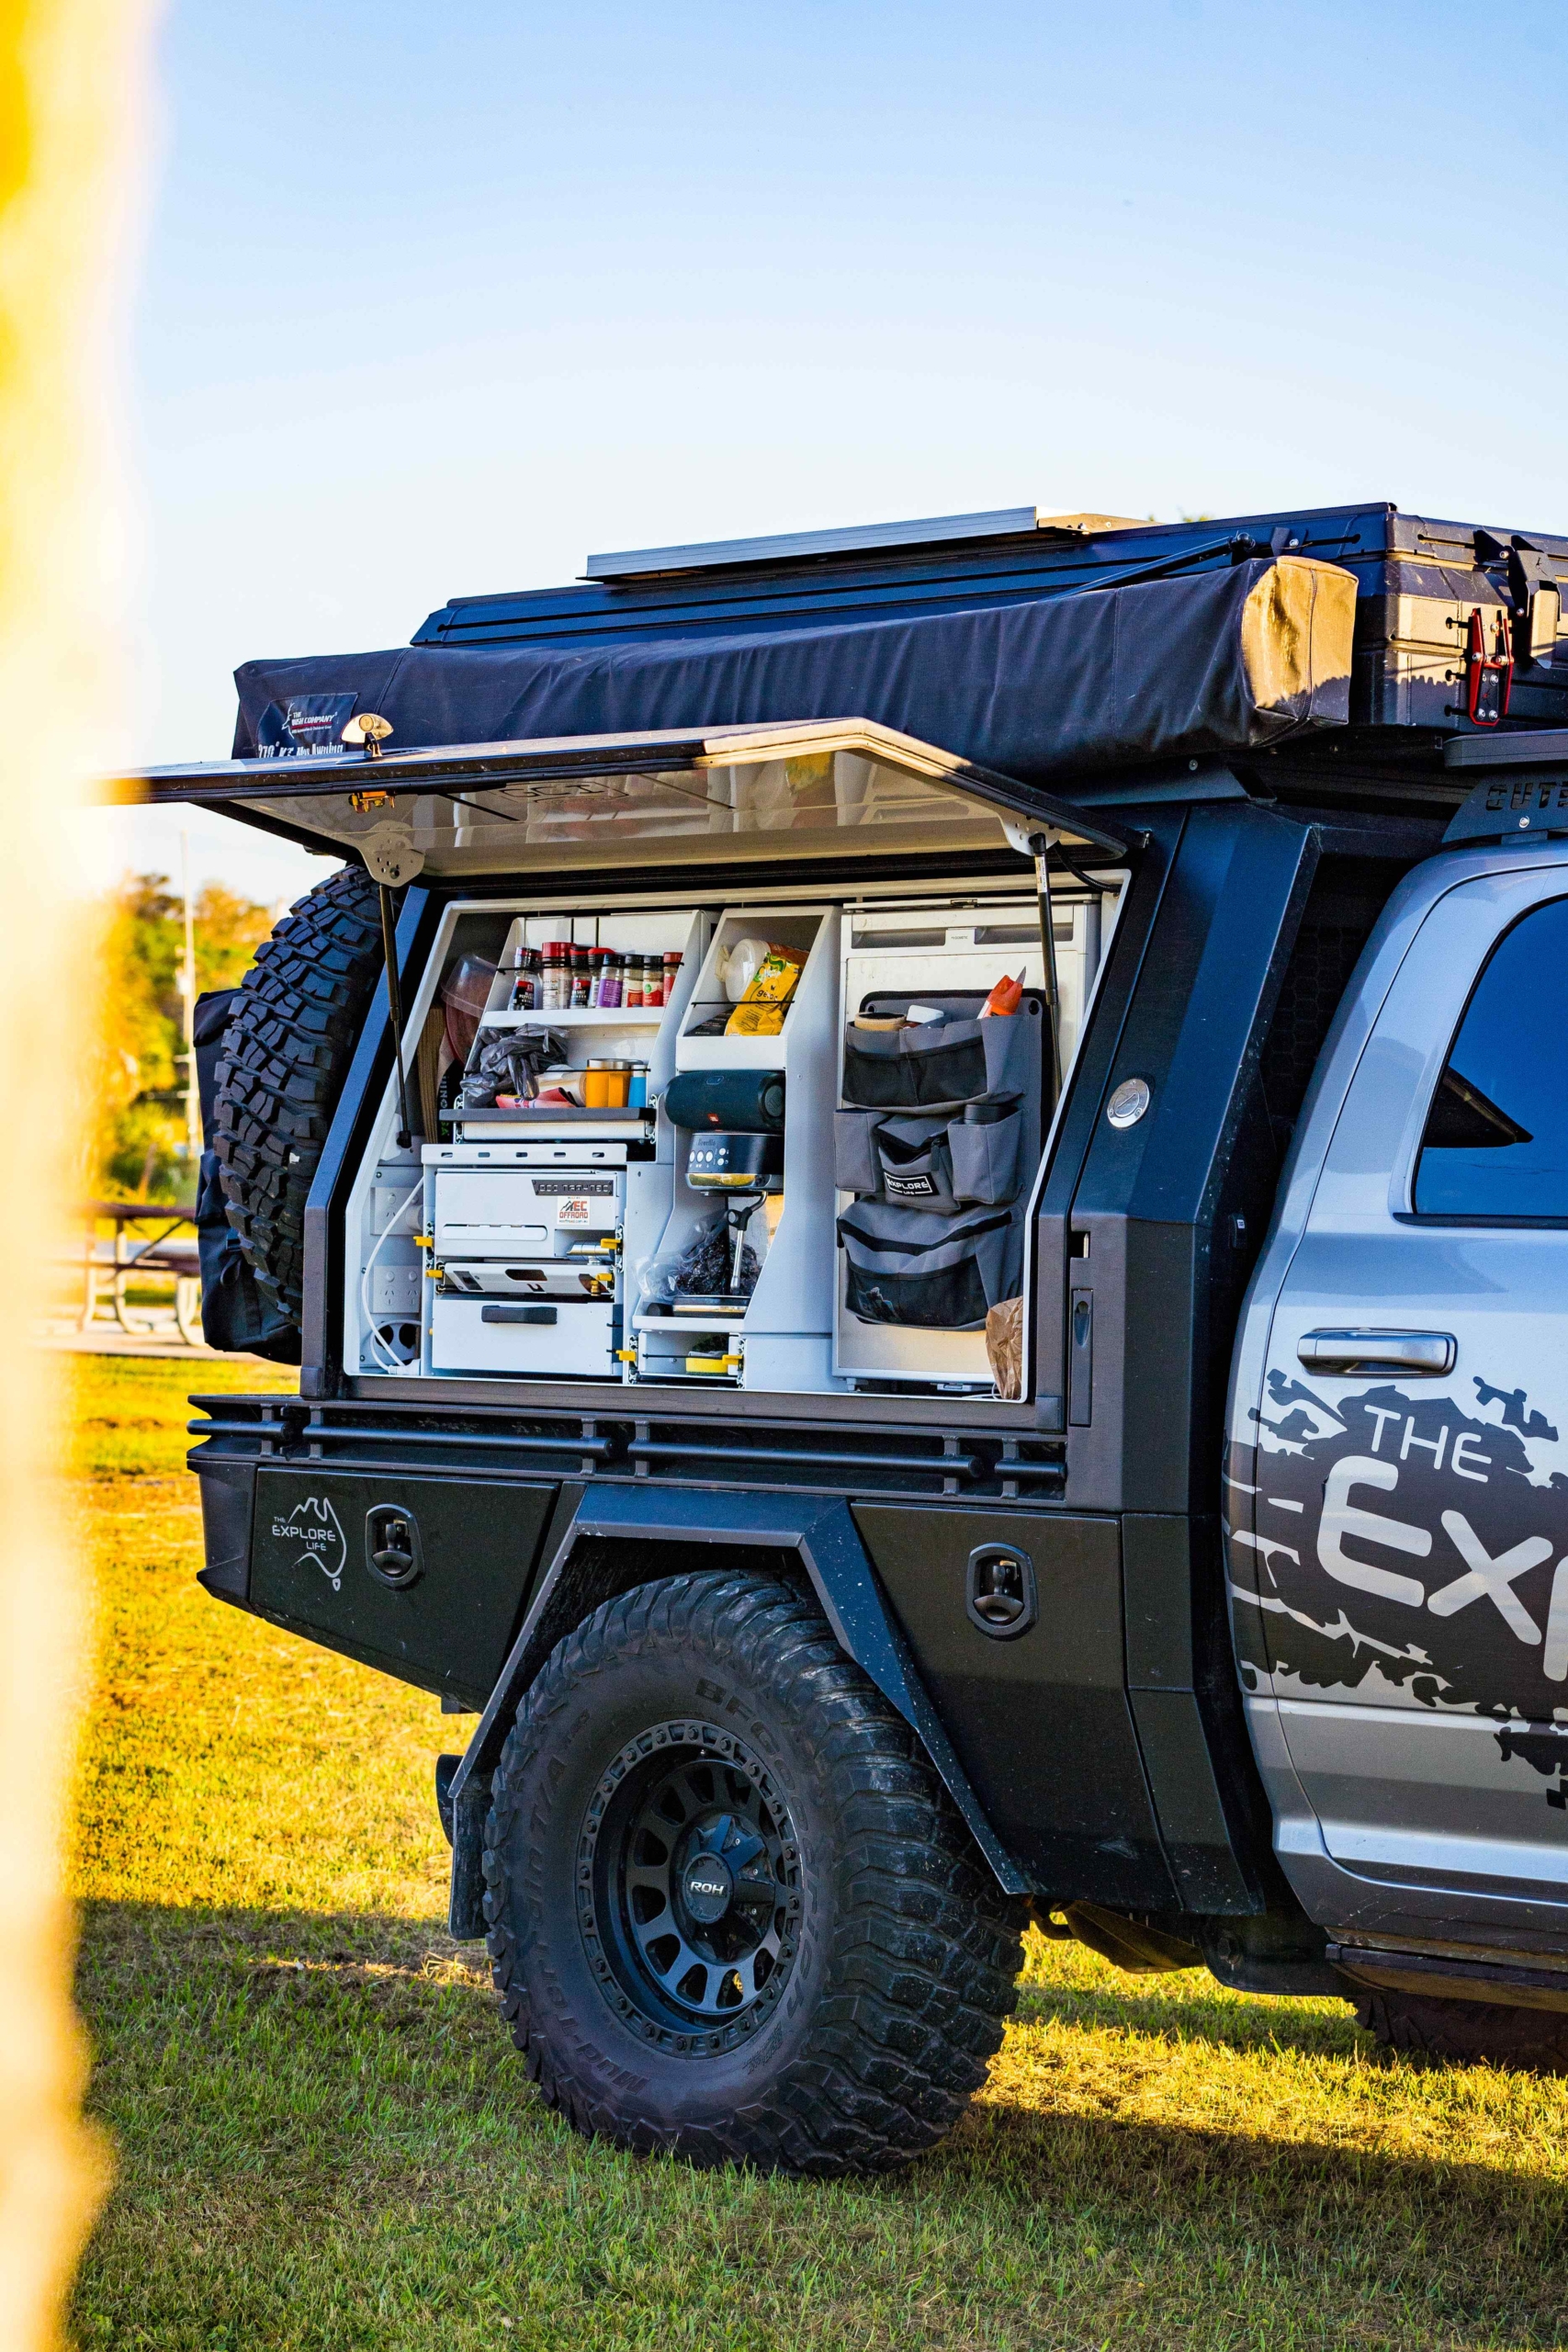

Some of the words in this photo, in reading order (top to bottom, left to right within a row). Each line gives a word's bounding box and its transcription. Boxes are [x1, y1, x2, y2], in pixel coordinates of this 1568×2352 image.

[304, 714, 335, 724] COMPANY
[887, 1179, 930, 1190] EXPLORE
[1364, 1404, 1492, 1483] THE
[272, 1524, 336, 1542] EXPLORE
[306, 1541, 327, 1552] LIFE
[1317, 1455, 1568, 1681] EX
[690, 1881, 725, 1895] ROH
